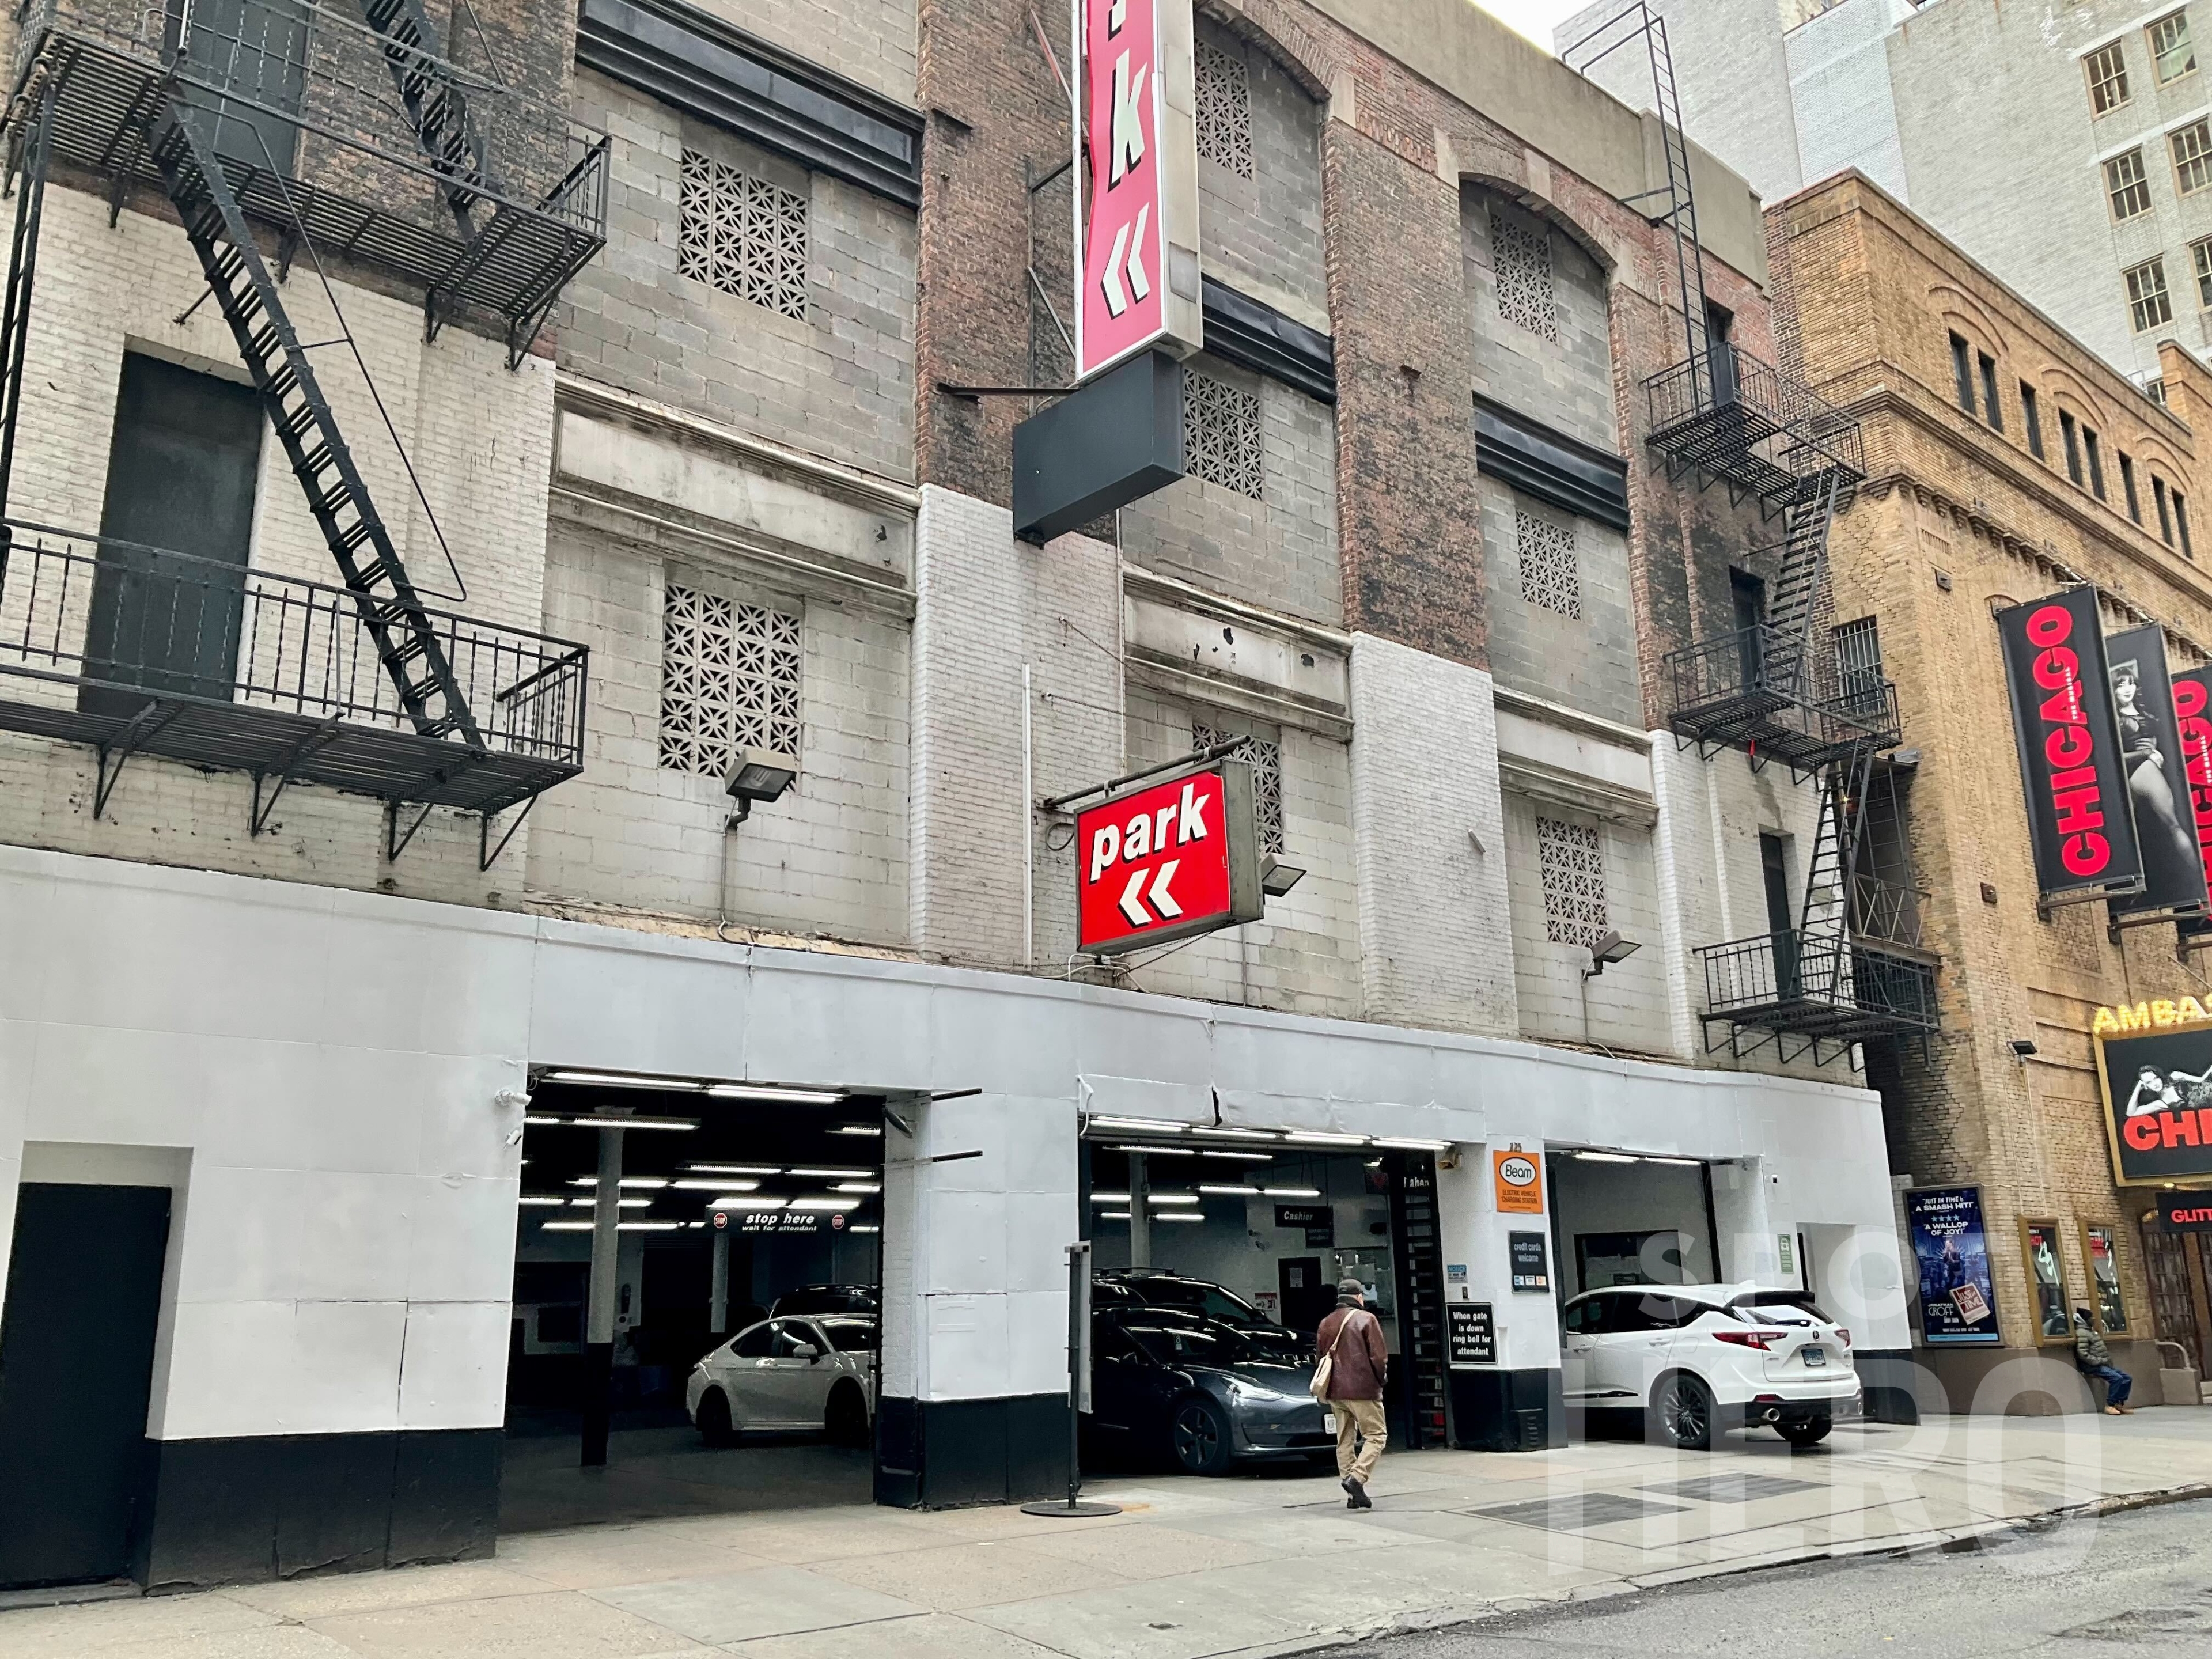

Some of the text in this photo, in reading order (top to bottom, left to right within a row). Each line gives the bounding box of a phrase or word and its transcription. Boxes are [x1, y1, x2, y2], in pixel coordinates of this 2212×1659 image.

[2026, 604, 2111, 876] CHICAGO
[1089, 783, 1210, 884] park
[1505, 1164, 1532, 1178] Beam
[746, 1213, 815, 1225] stop here
[1284, 1211, 1313, 1220] Cashier
[1932, 1221, 1968, 1229] WALLOP
[1514, 1242, 1541, 1251] credit cards
[1518, 1253, 1539, 1262] welcome
[1958, 1290, 1970, 1302] JUST
[1960, 1297, 1983, 1310] TIME
[1928, 1307, 1953, 1316] GROFF
[1453, 1312, 1487, 1321] When gate
[1458, 1324, 1464, 1332] is
[1453, 1335, 1491, 1344] ring bell for
[1457, 1347, 1488, 1355] attendant
